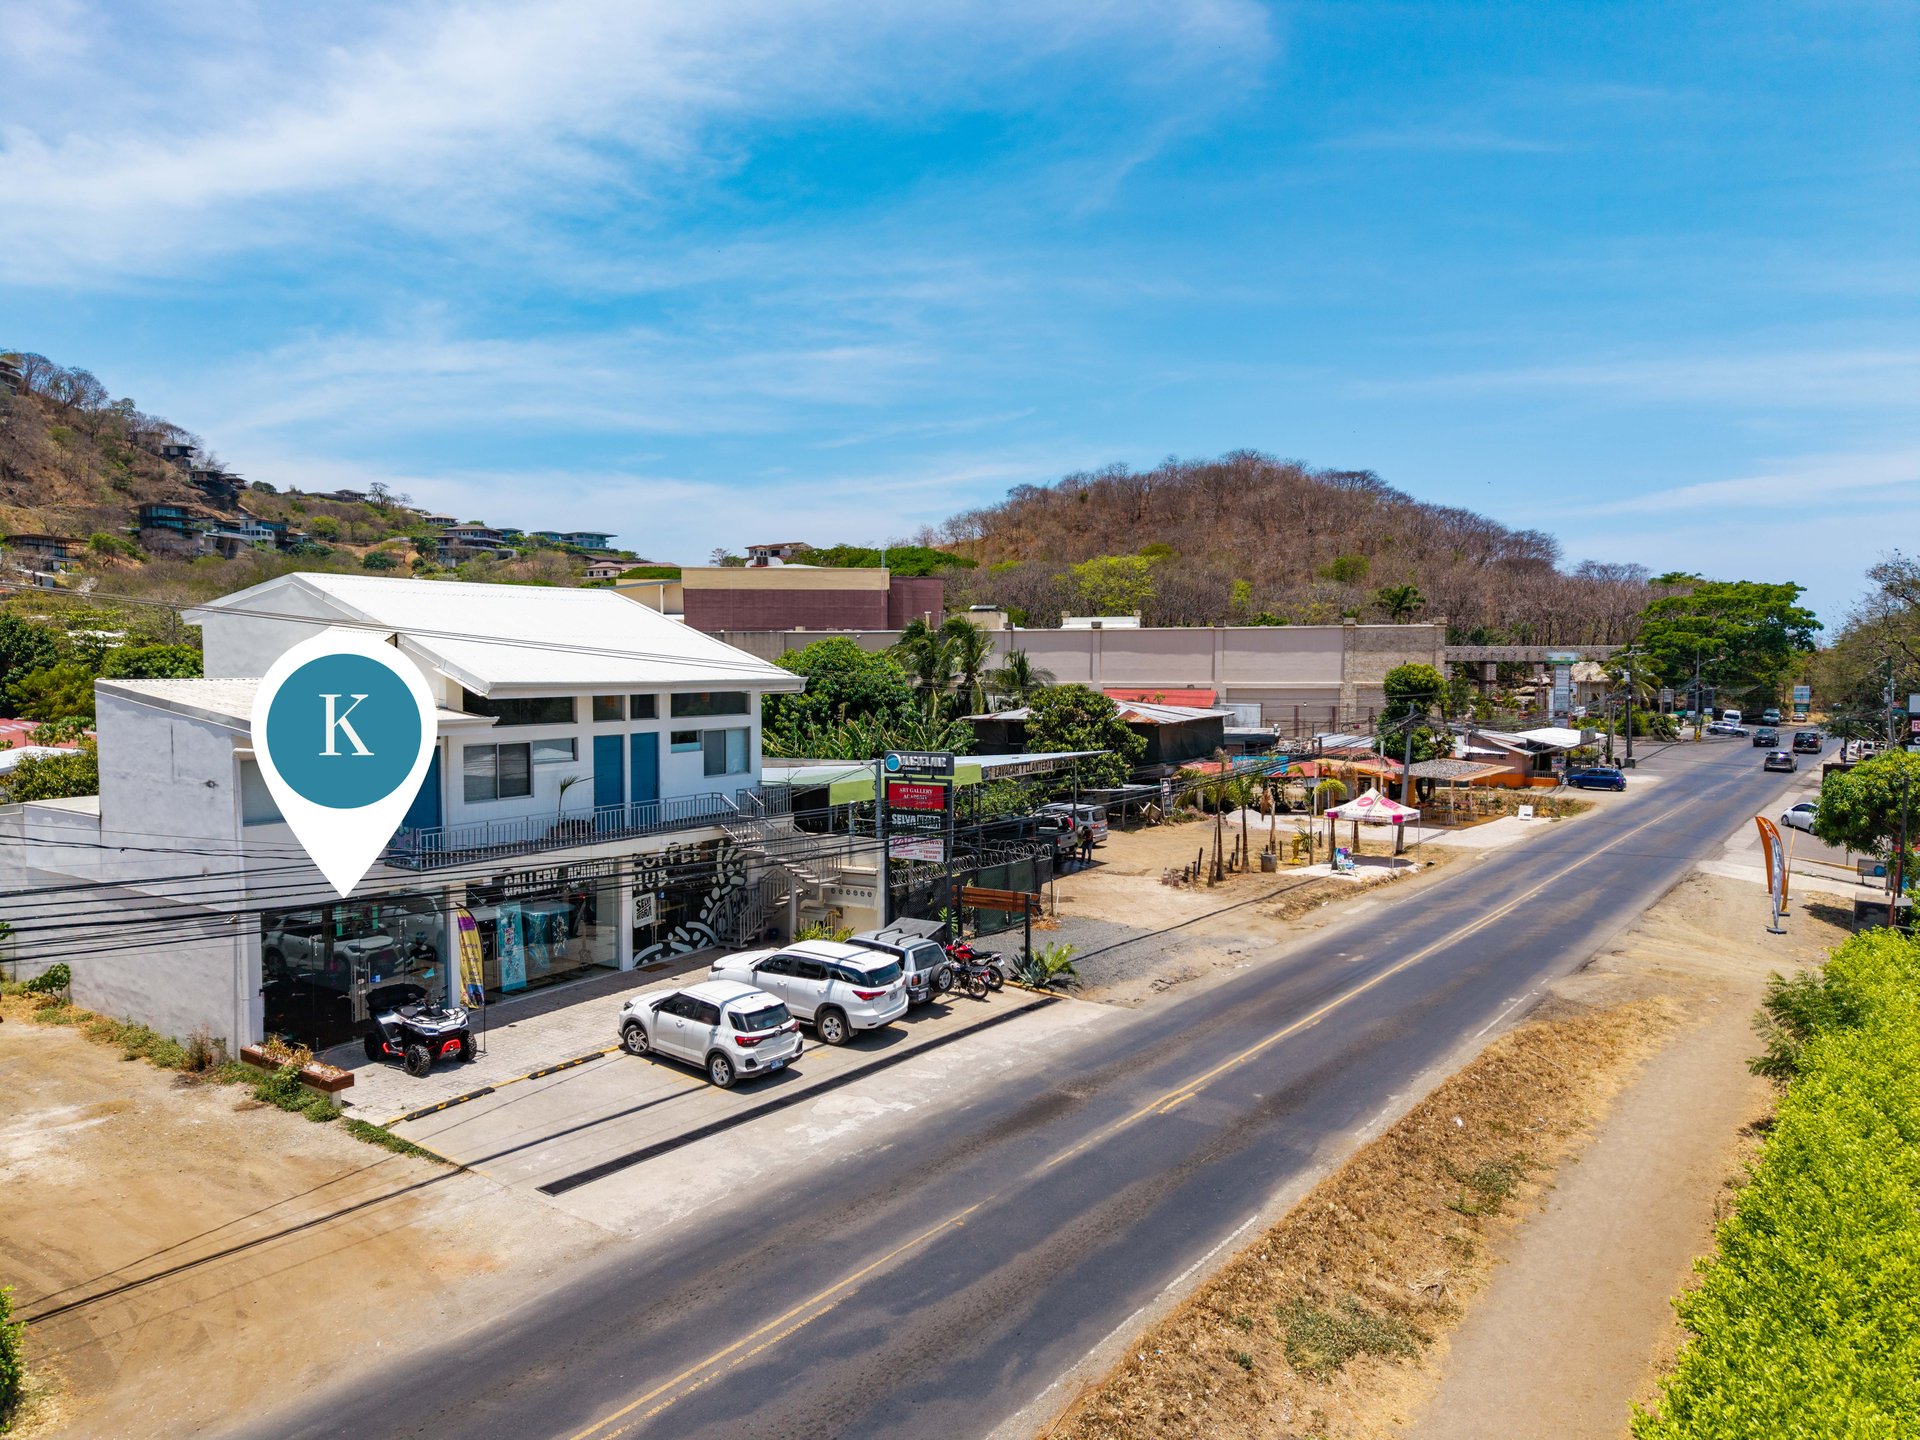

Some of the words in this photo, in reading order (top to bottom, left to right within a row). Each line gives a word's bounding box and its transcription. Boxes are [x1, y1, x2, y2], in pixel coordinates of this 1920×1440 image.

[994, 764, 1020, 777] LAVACAR
[1021, 764, 1025, 774] Y
[1025, 760, 1052, 773] LLANTERA
[891, 813, 916, 825] SELVA
[504, 868, 560, 897] GALLERY
[567, 858, 614, 885] ACADEMY
